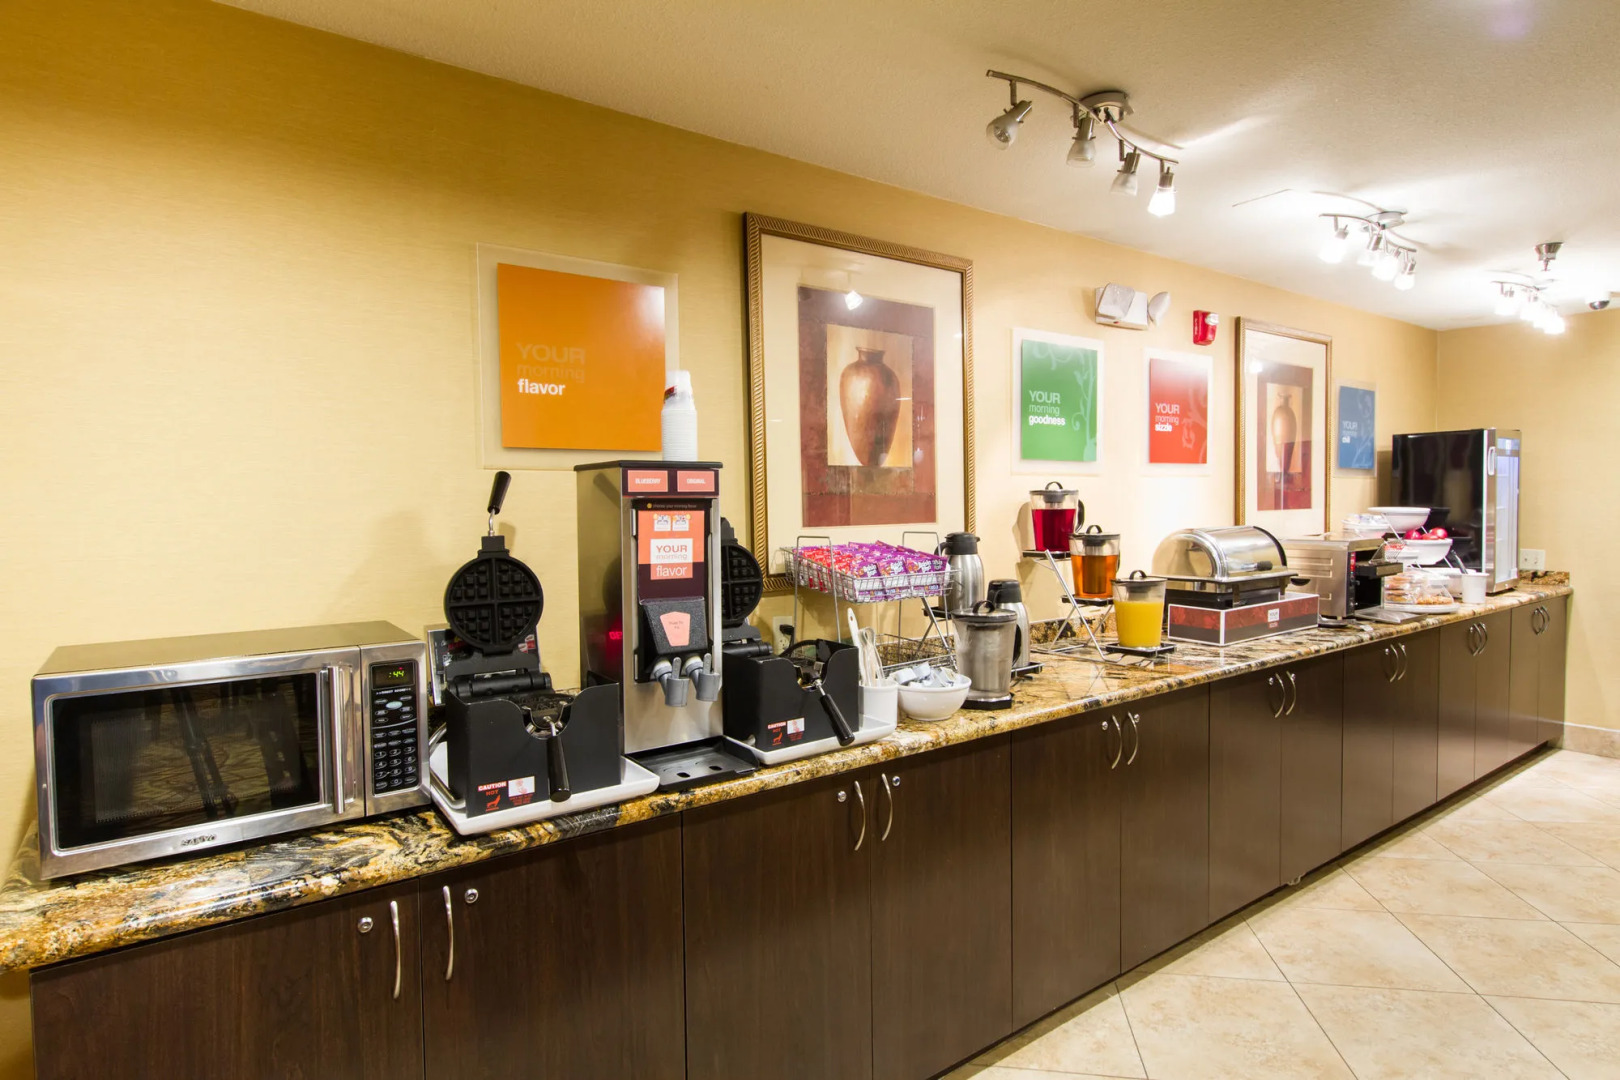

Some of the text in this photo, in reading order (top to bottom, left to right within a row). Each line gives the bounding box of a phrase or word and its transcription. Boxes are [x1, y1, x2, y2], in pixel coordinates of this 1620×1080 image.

[516, 342, 586, 365] YOUR
[517, 364, 585, 384] morning
[517, 378, 566, 396] flavor
[1029, 390, 1061, 404] YOUR
[1029, 404, 1060, 417] morning
[1155, 402, 1180, 415] YOUR
[1029, 414, 1066, 426] goodness
[1155, 415, 1180, 426] morning
[1155, 422, 1173, 432] sizzle
[656, 545, 688, 553] YOUR
[656, 553, 688, 561] morning
[656, 565, 688, 577] flavor
[478, 781, 507, 791] CAUTION
